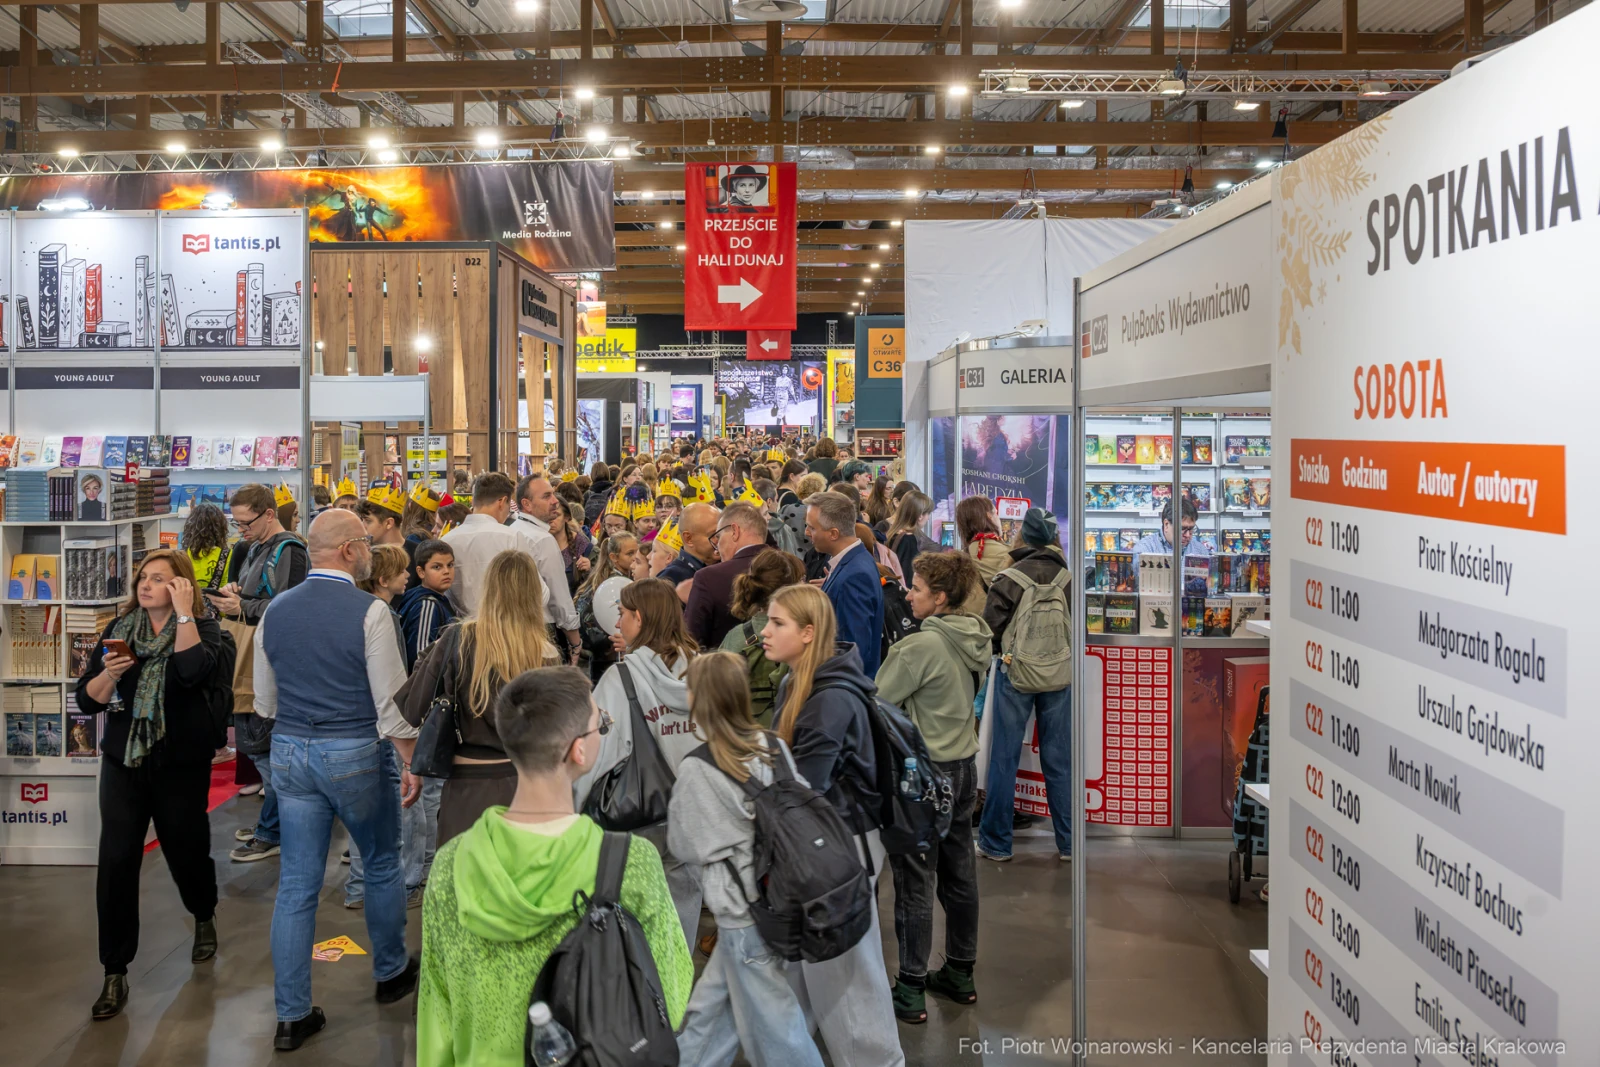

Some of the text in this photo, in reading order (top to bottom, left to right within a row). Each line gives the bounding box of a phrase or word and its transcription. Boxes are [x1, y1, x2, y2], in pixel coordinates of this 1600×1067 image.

[704, 218, 777, 232] PRZEJŚCIE
[1366, 126, 1582, 276] SPOTKANIA
[214, 236, 280, 252] tantis.pl
[465, 258, 481, 266] D22
[502, 230, 572, 239] Media Rodzina
[698, 254, 784, 266] HALI DUNAJ
[730, 237, 752, 249] DO
[1093, 282, 1250, 351] C23 PulpBooks Wydawnictwo
[967, 368, 1066, 386] C31 GALERIA
[1354, 358, 1448, 420] SOBOTA
[962, 468, 1026, 484] ROSHANI CHOKSHI
[1299, 454, 1538, 518] Stoisko Godzina Autor / autorzy
[1006, 508, 1014, 516] 60
[1306, 517, 1513, 596] C22 11:00 Piotr Kościelny
[1306, 578, 1545, 683] C22 11:00 Małgorzata Rogala
[1306, 640, 1544, 771] C22 11:00 Urszula Gajdowska
[1306, 702, 1460, 815] C22 11:00 Marta Nowik
[2, 810, 67, 826] tantis.pl
[1306, 764, 1523, 936] C22 12:00 Krzysztof Bochus
[1306, 826, 1526, 1027] C22 12:00 Wioletta Piasecka
[1305, 949, 1359, 1026] C22 13:00
[1306, 888, 1323, 925] C22
[1332, 908, 1360, 958] 13:00
[1415, 982, 1450, 1043] Emilia
[1304, 1010, 1322, 1052] C22
